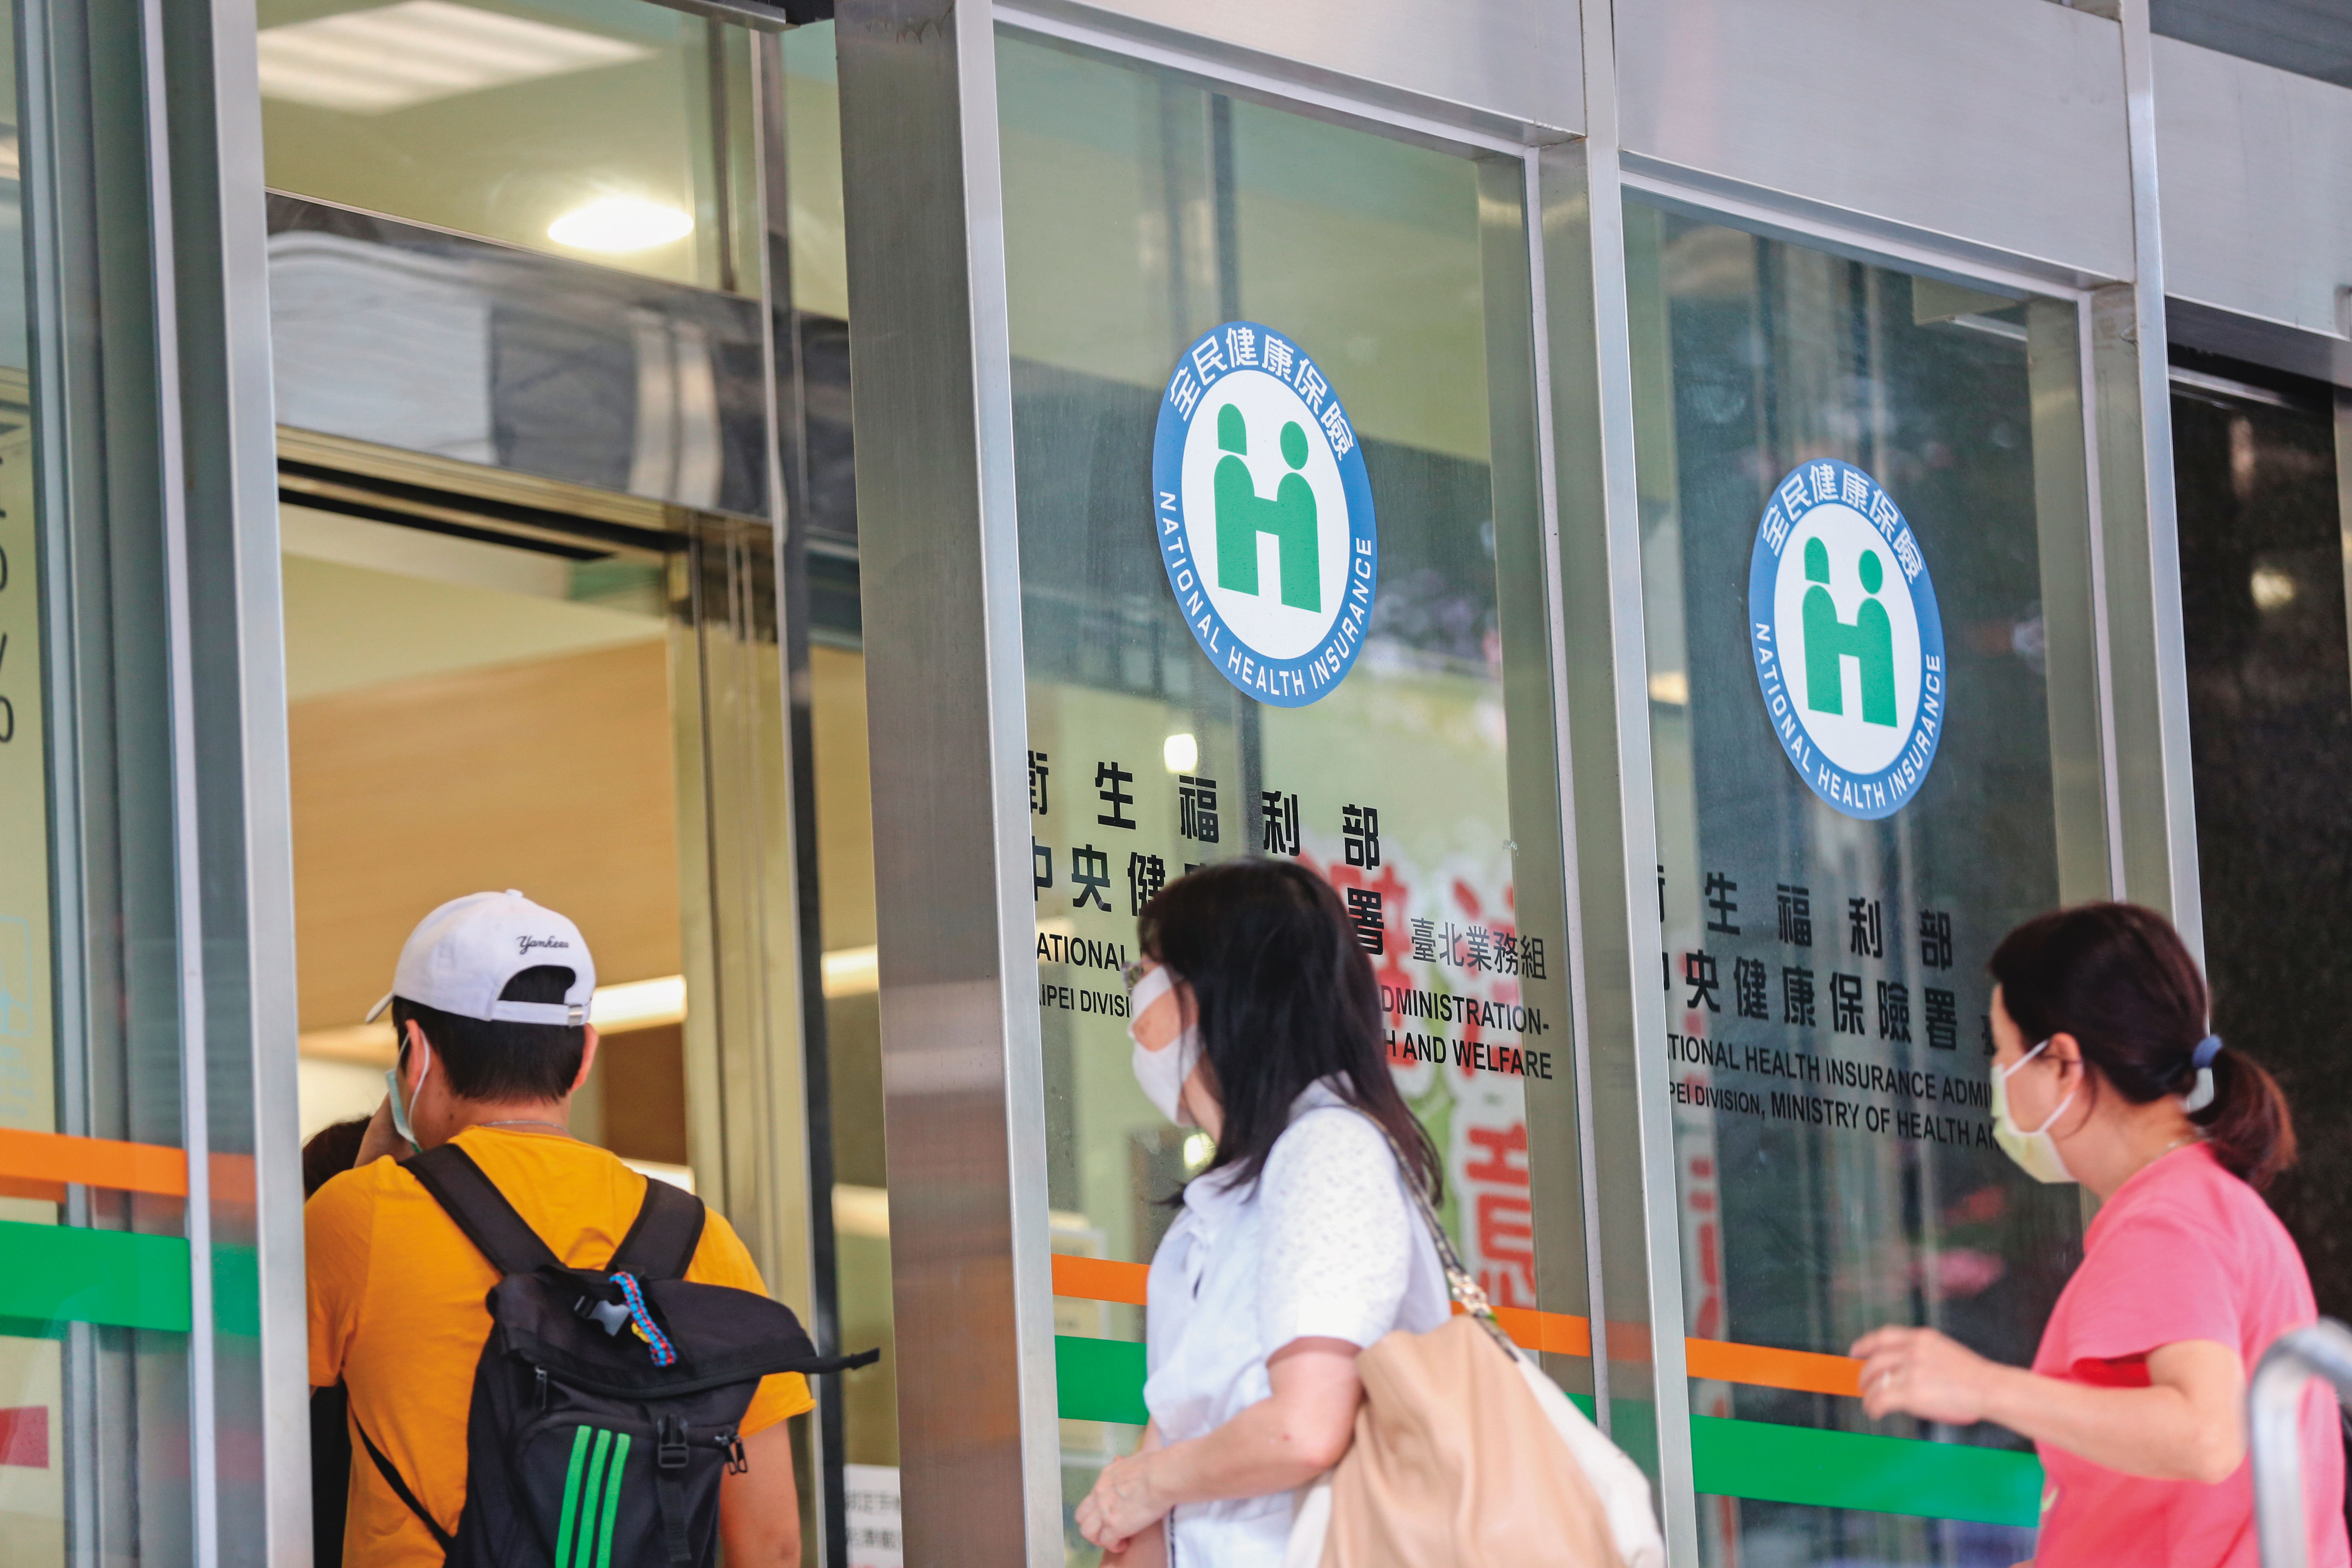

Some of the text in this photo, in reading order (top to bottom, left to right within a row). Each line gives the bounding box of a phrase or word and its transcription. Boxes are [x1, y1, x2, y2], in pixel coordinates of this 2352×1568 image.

[1170, 327, 1354, 461] 全民健康保險
[1762, 463, 1923, 585] 全民健康保險
[1160, 492, 1371, 696] NATIONAL HEALTH INSURANCE
[1756, 623, 1940, 809] NATIONAL HEALTH INSURANCE
[516, 935, 569, 955] Yankees
[1410, 917, 1546, 980] 臺北業務組
[1657, 864, 1953, 971] 生福利部
[1080, 989, 1133, 1018] DIVISI
[1403, 1032, 1446, 1064] AND
[1452, 1039, 1552, 1079] WELFARE
[1381, 985, 1549, 1035] DMINISTRATION-
[1662, 949, 1957, 1051] 央健康保險署
[1668, 1033, 1740, 1070] TIONAL
[1745, 1045, 1820, 1082] HEALTH
[1826, 1058, 1937, 1100] INSURANCE
[1695, 1085, 1765, 1120] DIVISION,
[1771, 1091, 1859, 1129] MINISTRY
[1865, 1105, 1890, 1134] OF
[1896, 1109, 1971, 1146] HEALTH
